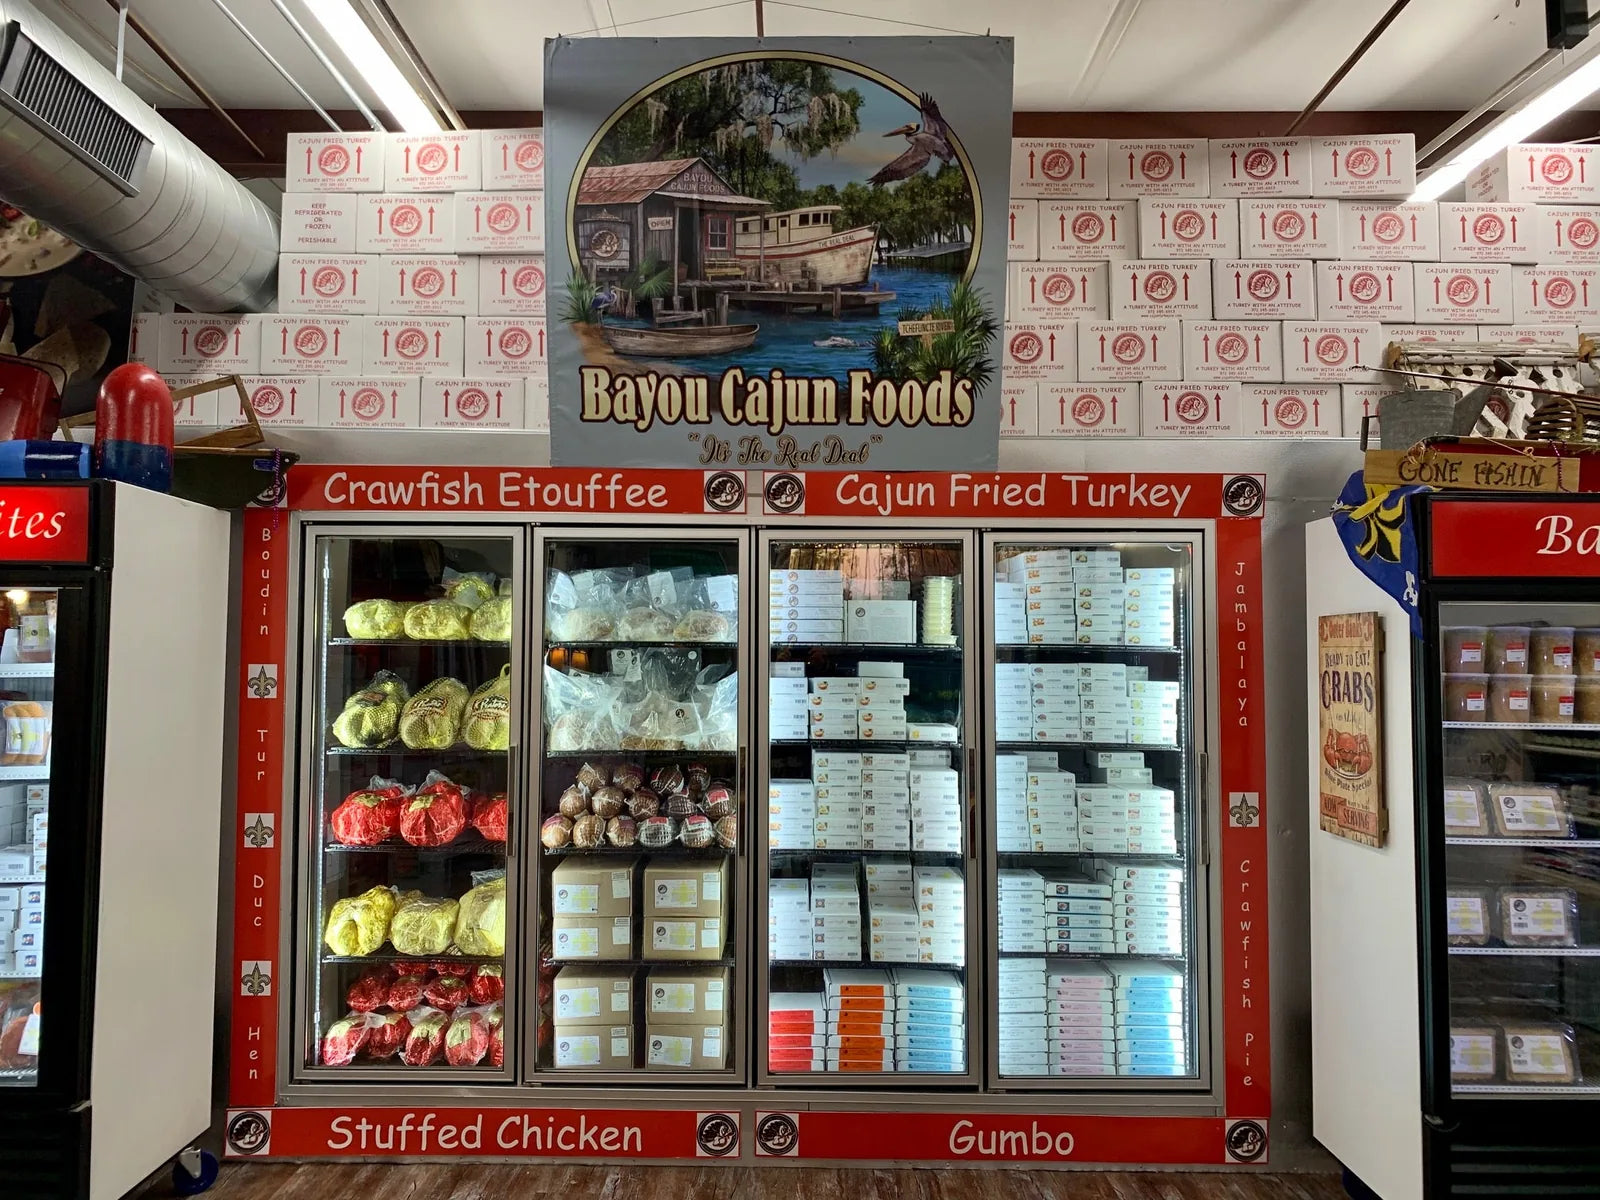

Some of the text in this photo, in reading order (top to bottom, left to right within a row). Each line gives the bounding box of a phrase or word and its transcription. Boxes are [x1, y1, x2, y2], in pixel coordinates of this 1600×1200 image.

[1221, 140, 1298, 149] CAJUN FRIED TURKEY
[670, 182, 725, 192] CAJUN FOODS
[683, 172, 713, 182] BAYOU
[580, 366, 975, 434] Bayou Cajun Foods
[737, 436, 773, 465] The
[774, 434, 822, 470] Real
[1398, 458, 1462, 482] GONE
[324, 471, 668, 508] Crawfish Etouffee
[836, 474, 1192, 517] Cajun Fried Turkey
[260, 528, 272, 636] Boudin
[1235, 562, 1248, 727] Jambalaya
[1322, 670, 1373, 712] CRABS
[1344, 808, 1369, 830] SERVING
[1240, 860, 1254, 1086] Crawfish Pie
[327, 1114, 642, 1152] Stuffed Chicken
[949, 1120, 1075, 1156] Gumbo
